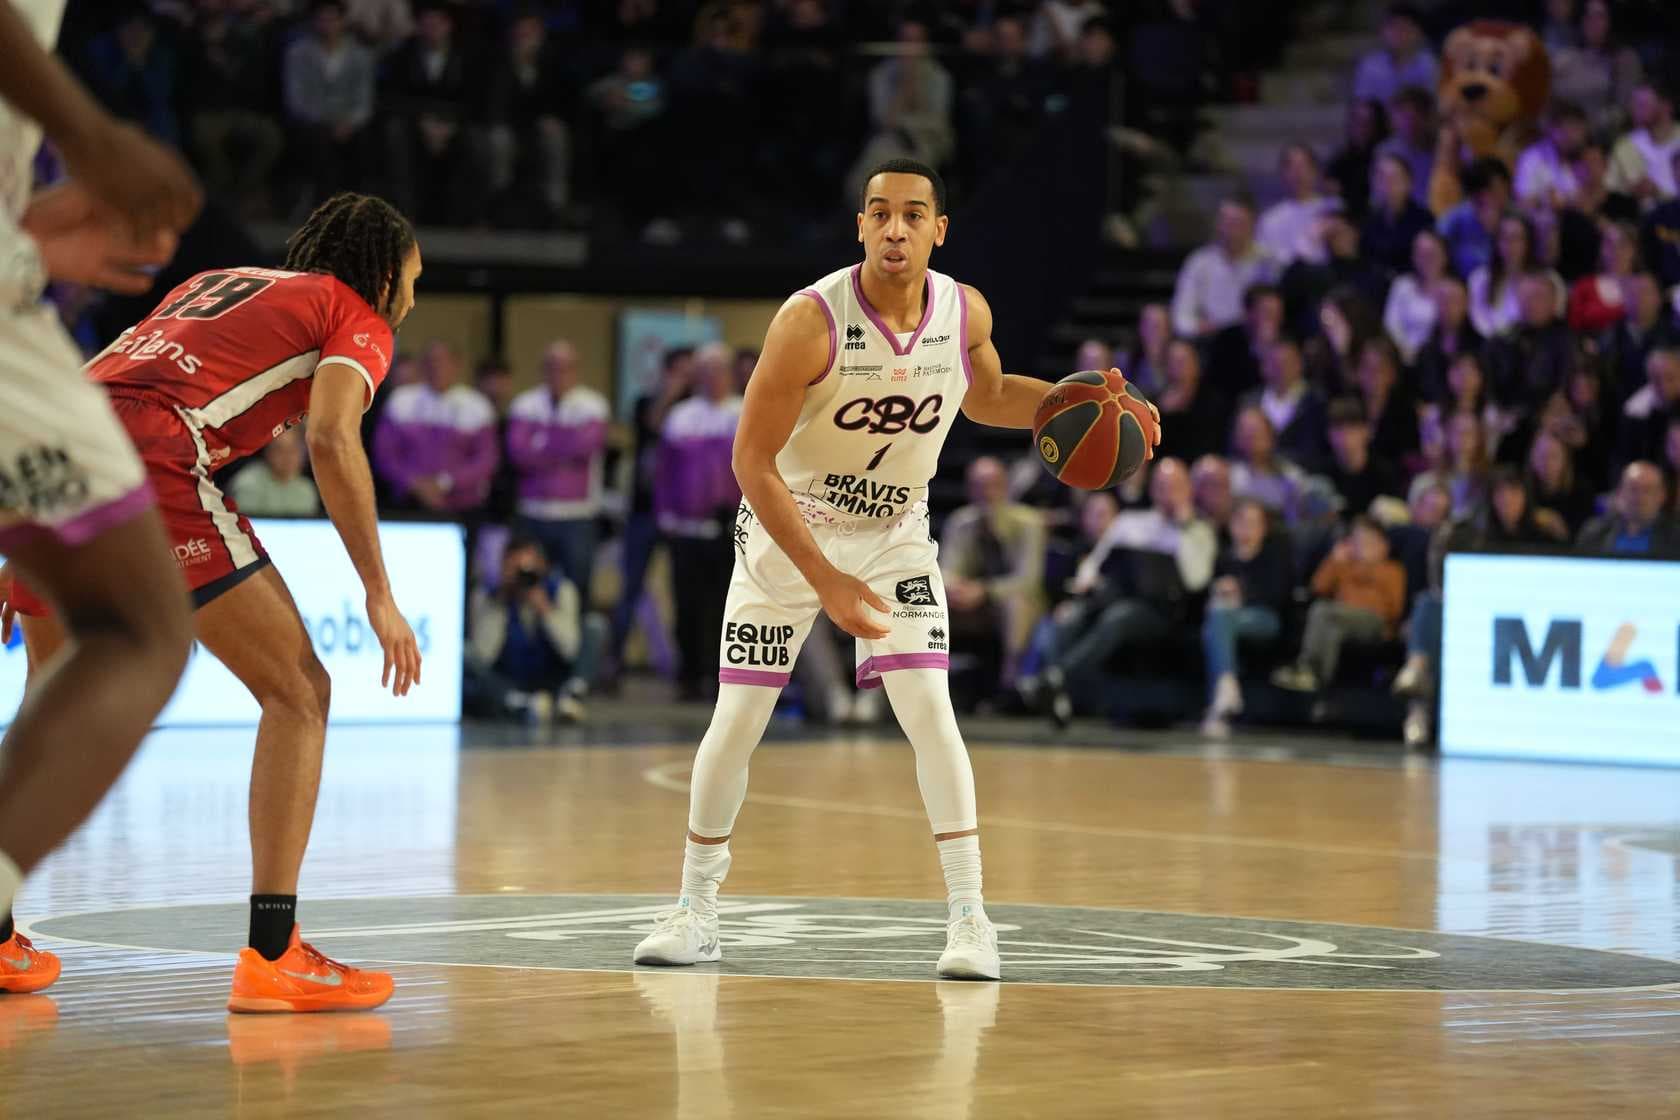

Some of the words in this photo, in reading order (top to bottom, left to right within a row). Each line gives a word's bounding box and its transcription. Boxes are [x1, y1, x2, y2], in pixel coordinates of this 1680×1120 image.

[153, 272, 277, 320] 19
[833, 394, 944, 434] CBC
[865, 442, 893, 471] 1
[823, 473, 911, 505] BRAVIS
[825, 490, 894, 518] IMMO
[892, 611, 945, 619] NORMANDIE
[725, 622, 794, 645] EQUIP
[726, 643, 790, 666] CLUB
[1493, 616, 1680, 695] MA
